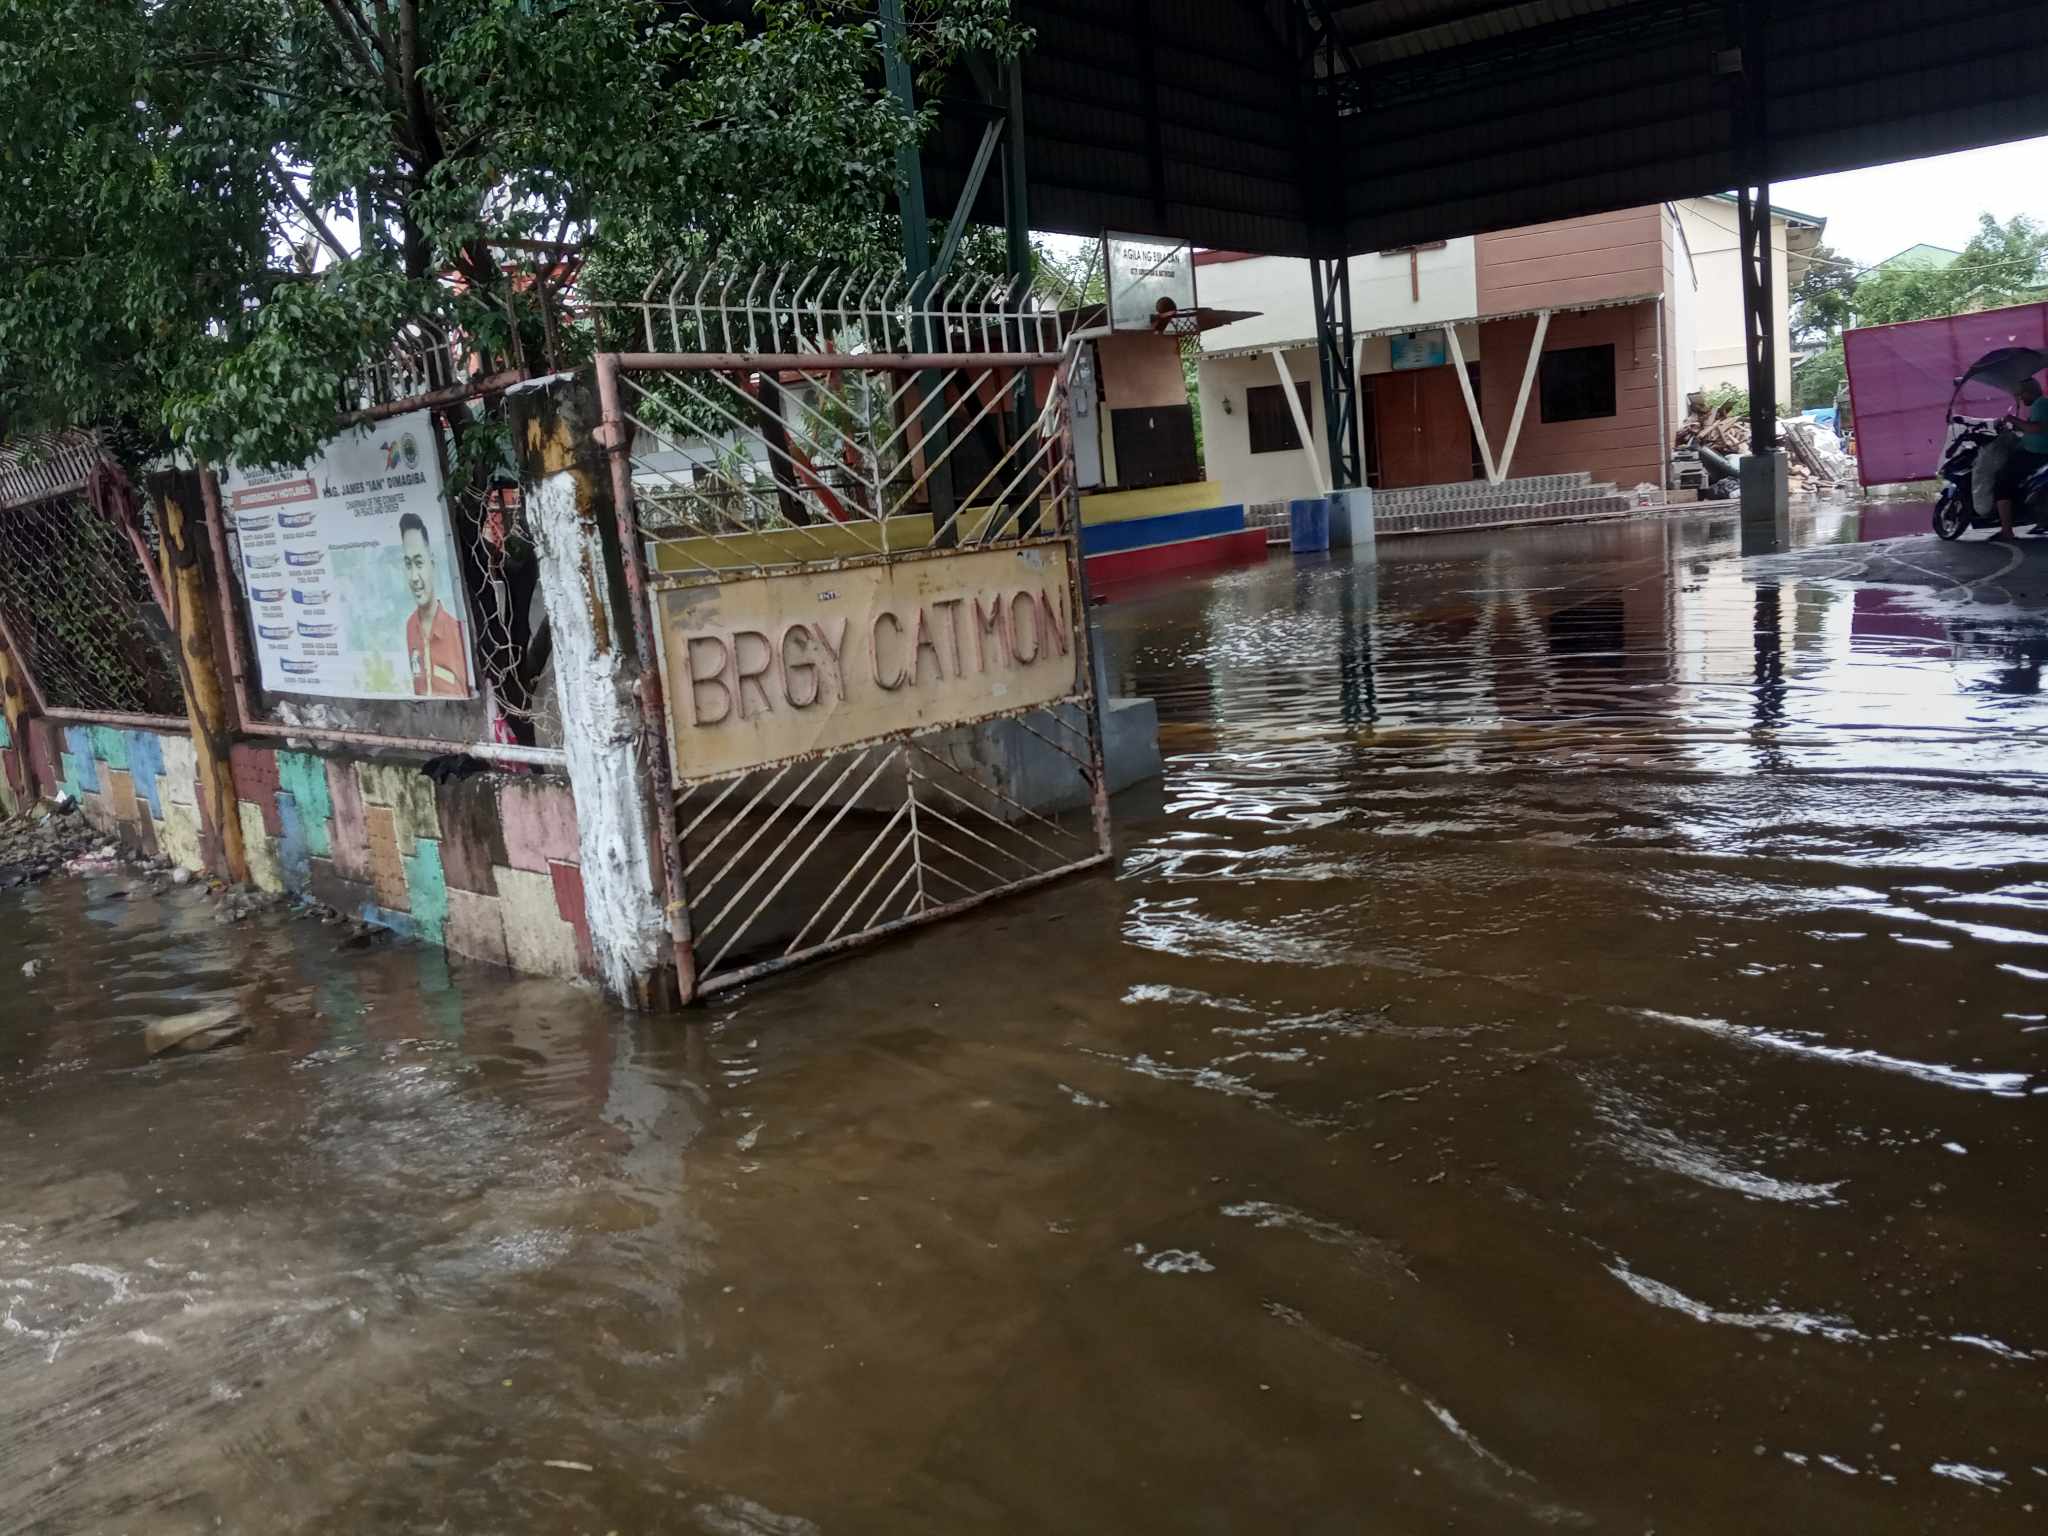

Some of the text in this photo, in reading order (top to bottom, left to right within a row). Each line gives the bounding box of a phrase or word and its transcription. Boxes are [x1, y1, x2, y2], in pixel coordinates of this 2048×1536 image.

[341, 481, 365, 496] JAMES
[387, 472, 426, 489] DIMAGIBA
[685, 584, 1070, 727] BRGY CATMON
